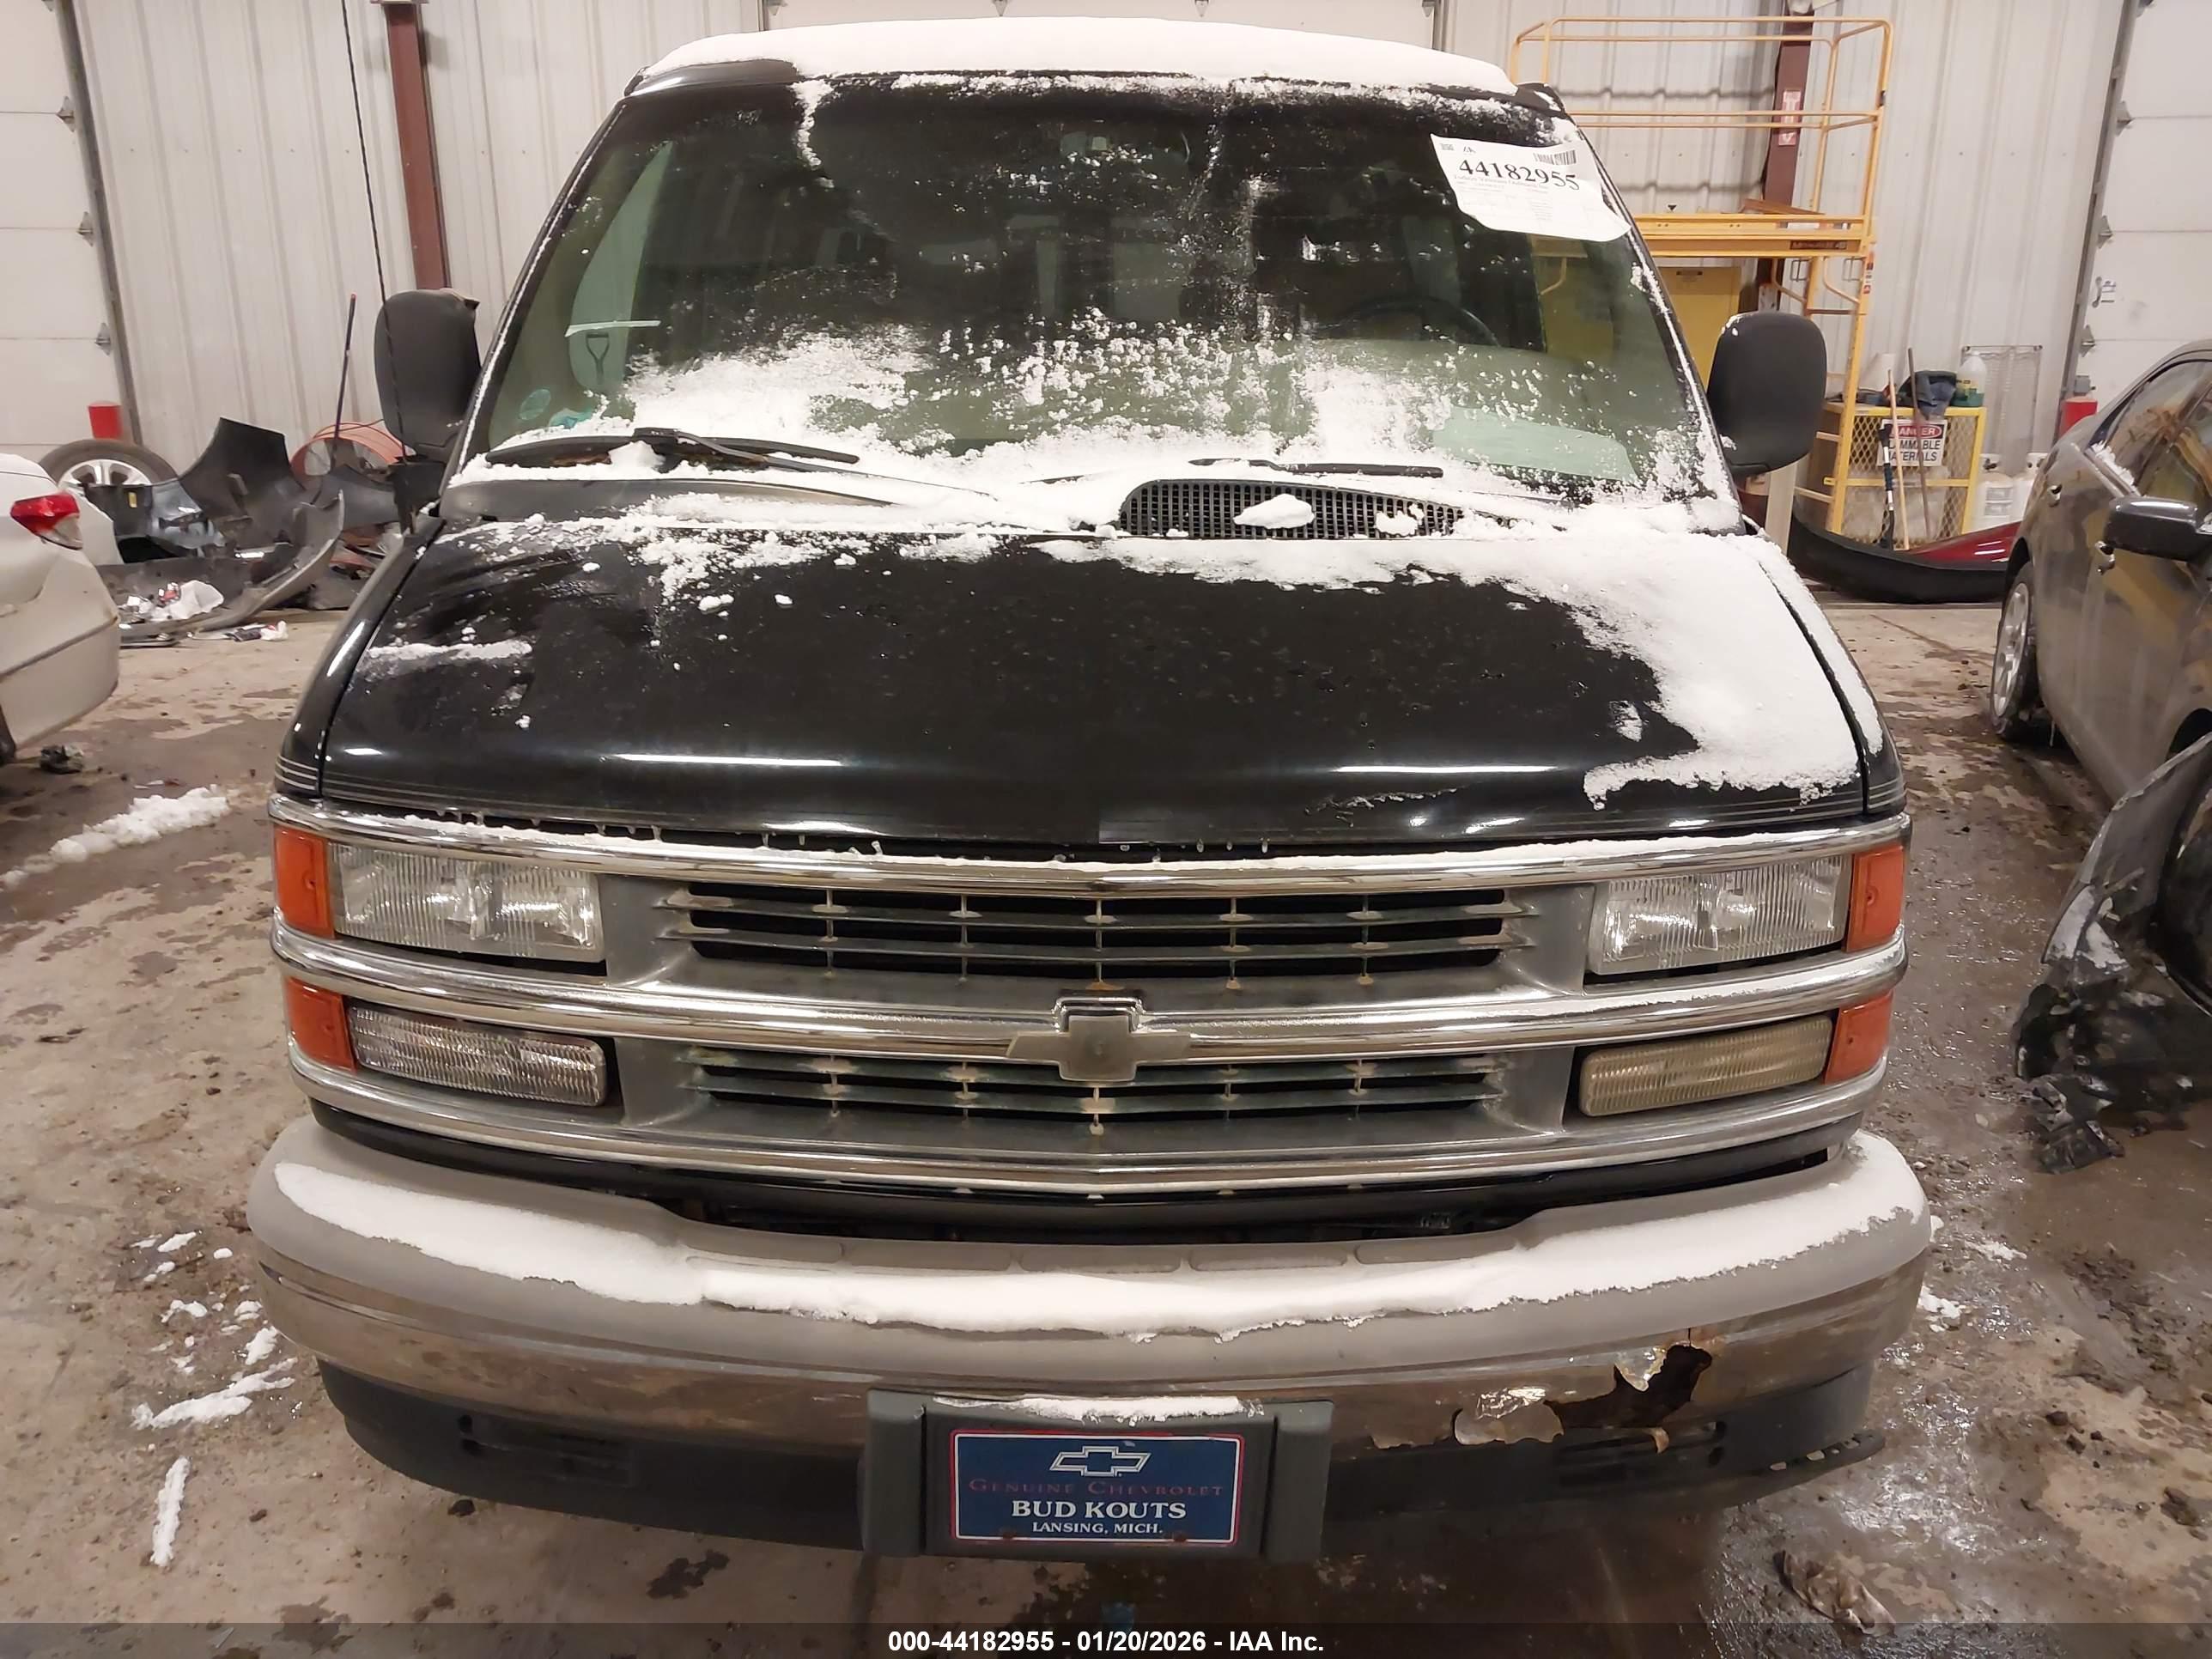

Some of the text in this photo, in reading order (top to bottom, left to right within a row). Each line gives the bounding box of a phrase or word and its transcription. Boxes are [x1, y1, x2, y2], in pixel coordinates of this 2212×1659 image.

[1459, 160, 1580, 191] 44182955
[1887, 440, 1942, 450] LMMBLE
[1883, 452, 1938, 462] AERILS
[969, 1479, 1224, 1497] GENUINE CHEVROLET
[1012, 1500, 1187, 1519] BUD KOUTS
[1032, 1522, 1163, 1534] LANSING, MICH.
